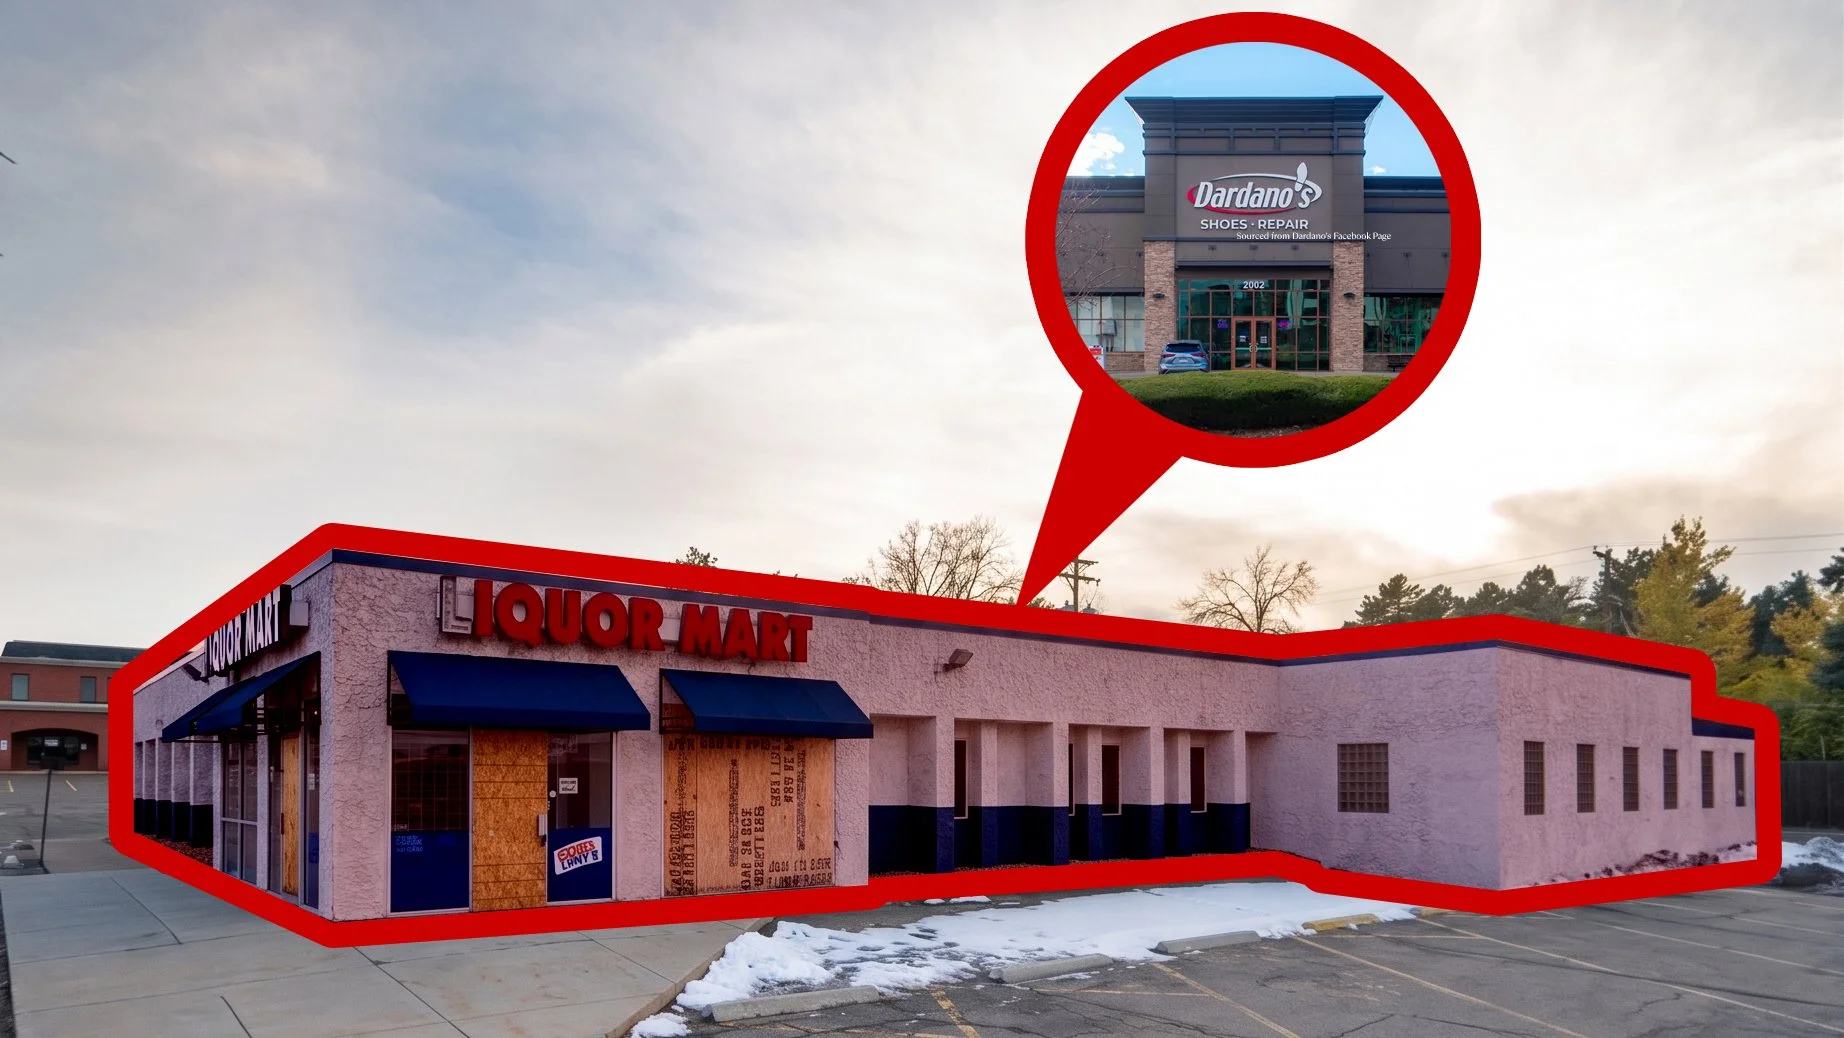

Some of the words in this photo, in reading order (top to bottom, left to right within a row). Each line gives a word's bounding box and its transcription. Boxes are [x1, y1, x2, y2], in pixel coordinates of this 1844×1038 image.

[1193, 170, 1315, 209] Dardano's
[1200, 219, 1247, 230] SHOES
[1257, 219, 1309, 230] REPAIR
[1243, 281, 1265, 289] 2002
[244, 586, 281, 657] MART
[439, 574, 665, 652] LIQUOR
[677, 603, 814, 663] MART
